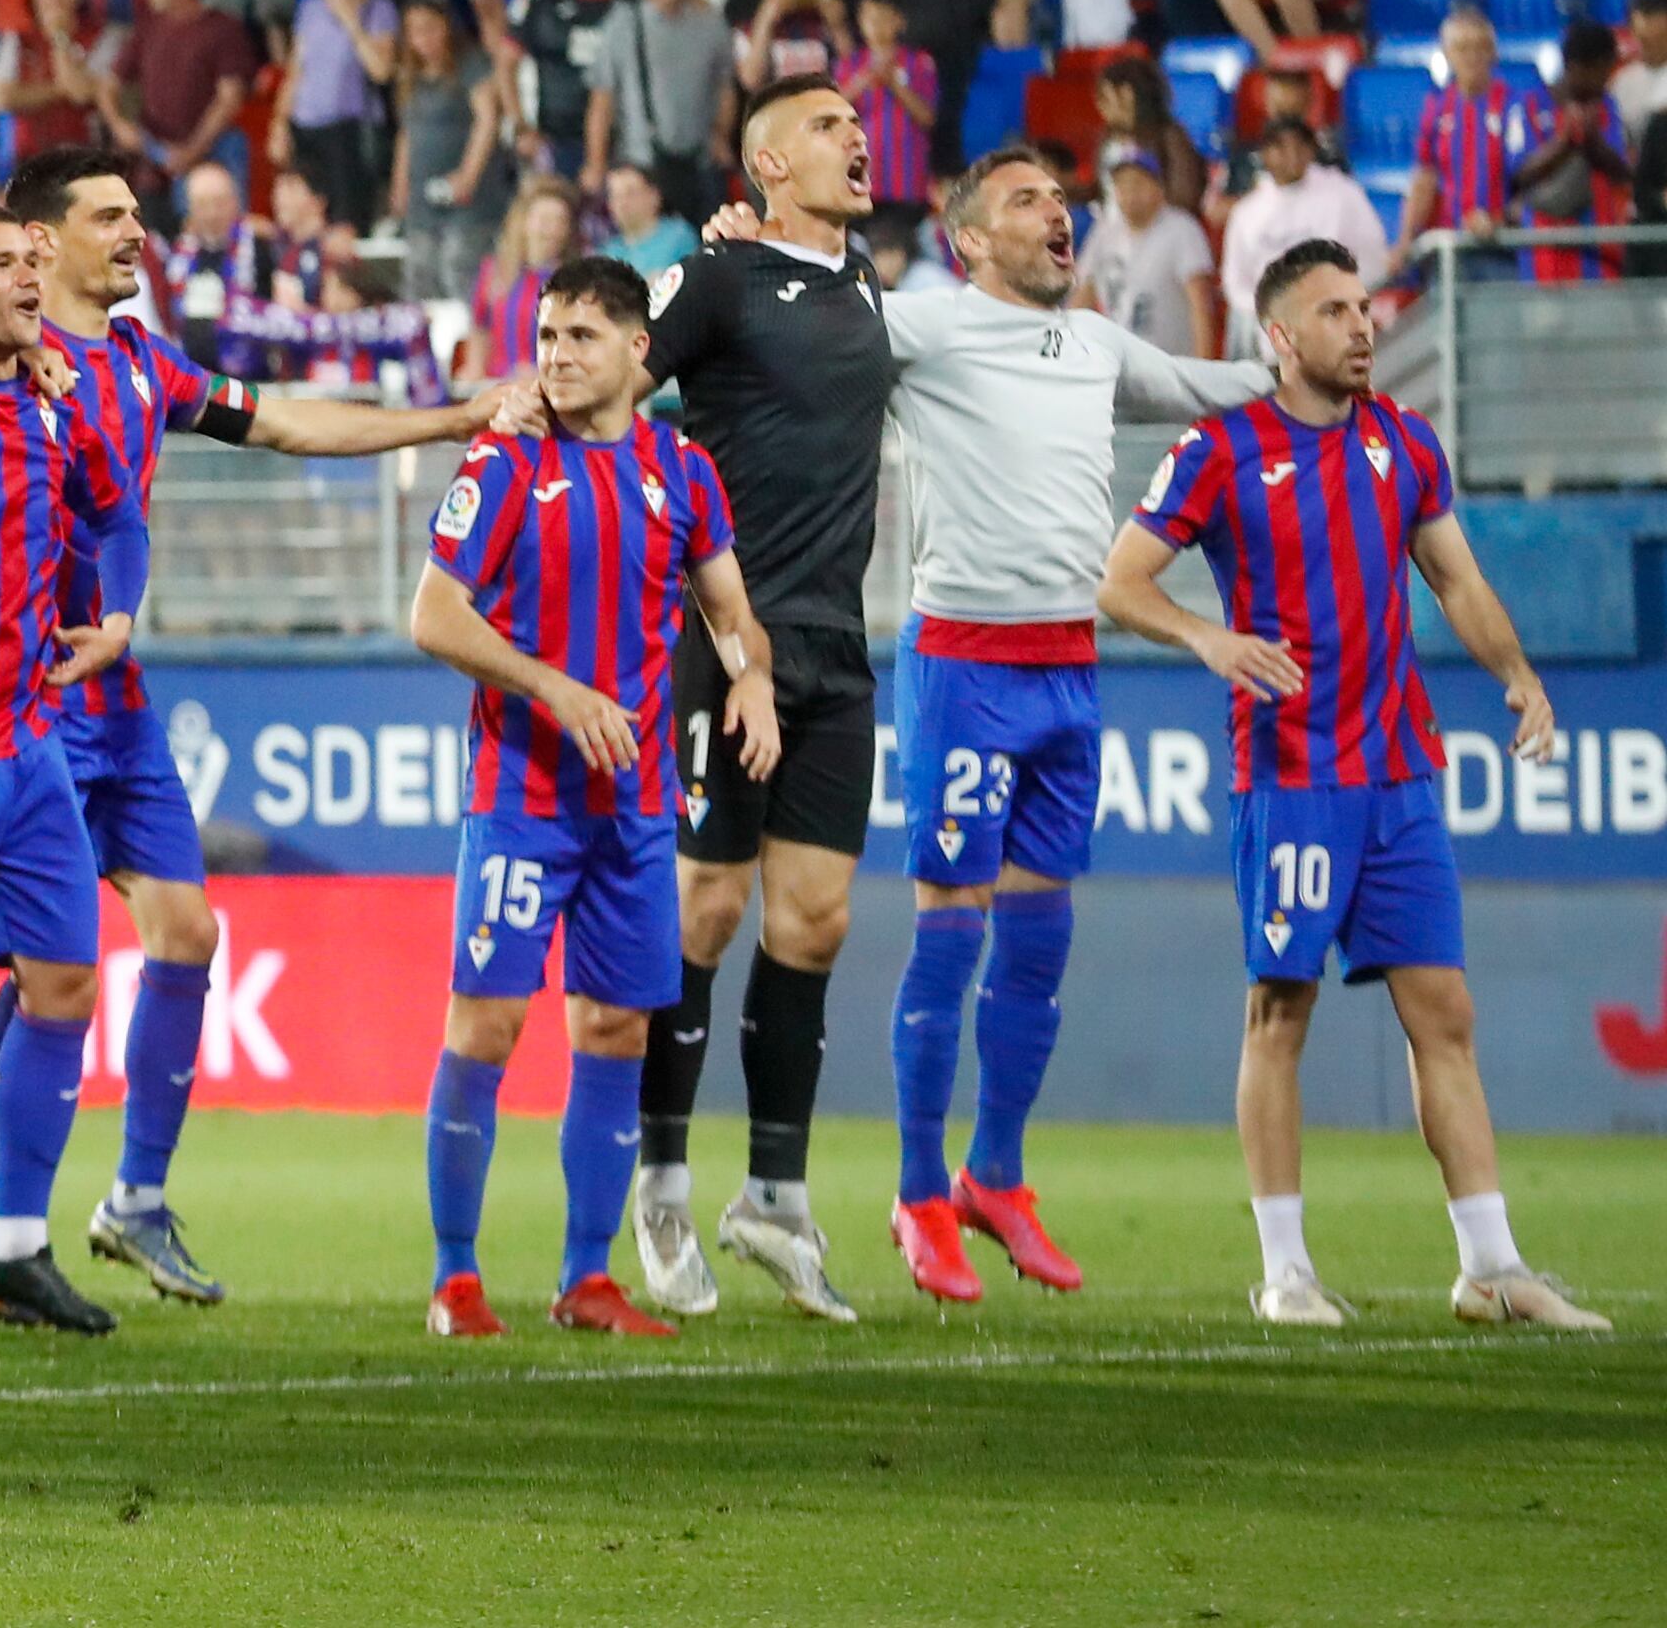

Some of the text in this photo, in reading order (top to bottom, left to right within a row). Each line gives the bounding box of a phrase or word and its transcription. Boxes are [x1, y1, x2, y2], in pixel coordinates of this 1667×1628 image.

[253, 722, 468, 828] SDEI
[943, 746, 1014, 817] 23
[1444, 728, 1667, 835] DEIB
[479, 853, 544, 931] 15
[1270, 840, 1332, 912] 10
